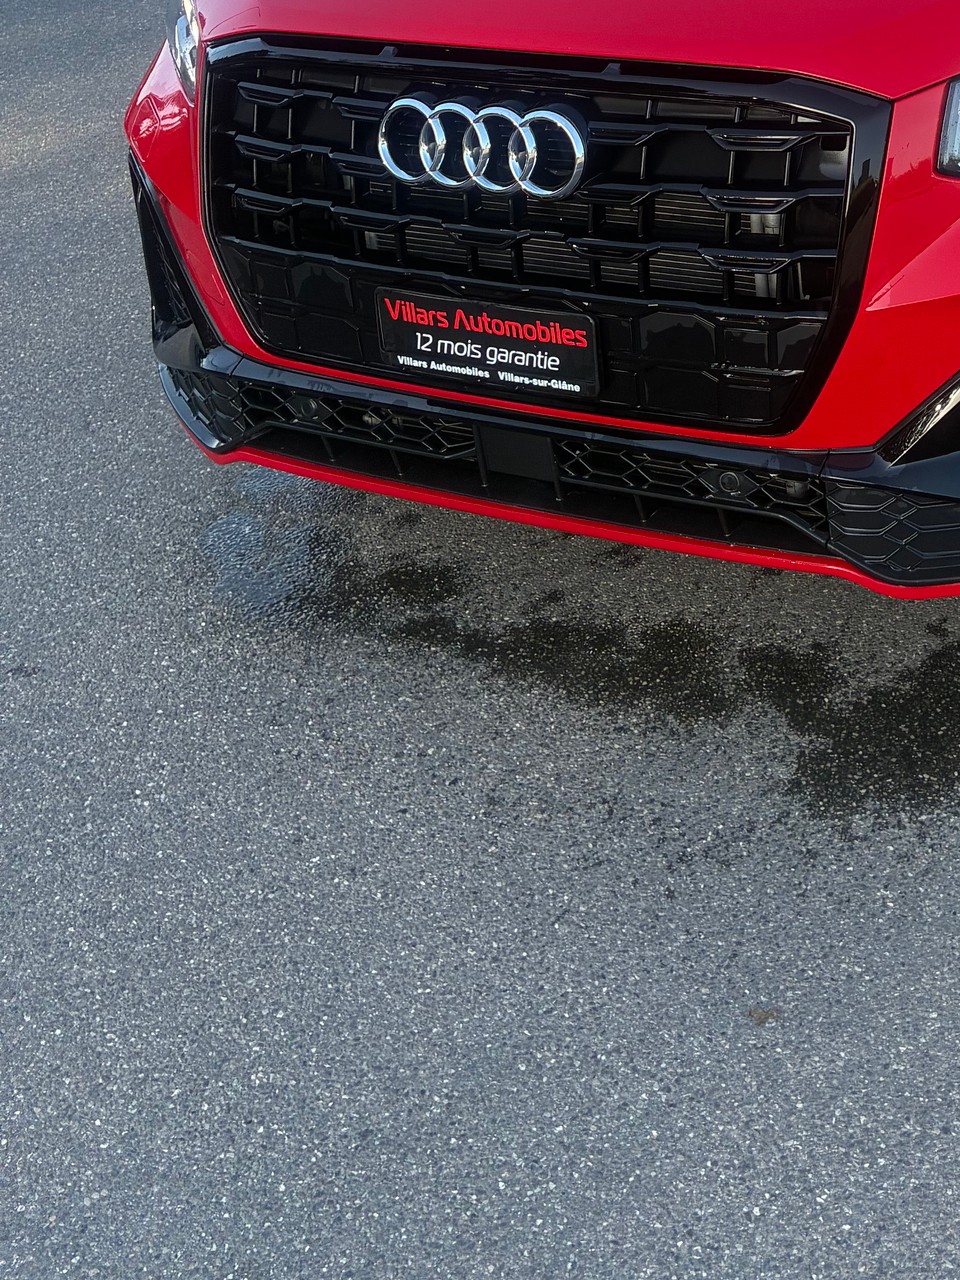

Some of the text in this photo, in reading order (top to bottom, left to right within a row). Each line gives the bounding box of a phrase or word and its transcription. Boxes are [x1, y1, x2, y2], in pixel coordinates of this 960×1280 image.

[384, 298, 588, 348] Villars Automobiles
[415, 332, 560, 371] 12 mois garantie
[397, 355, 581, 393] Villars Automobiles Villars-sur-Glâne
